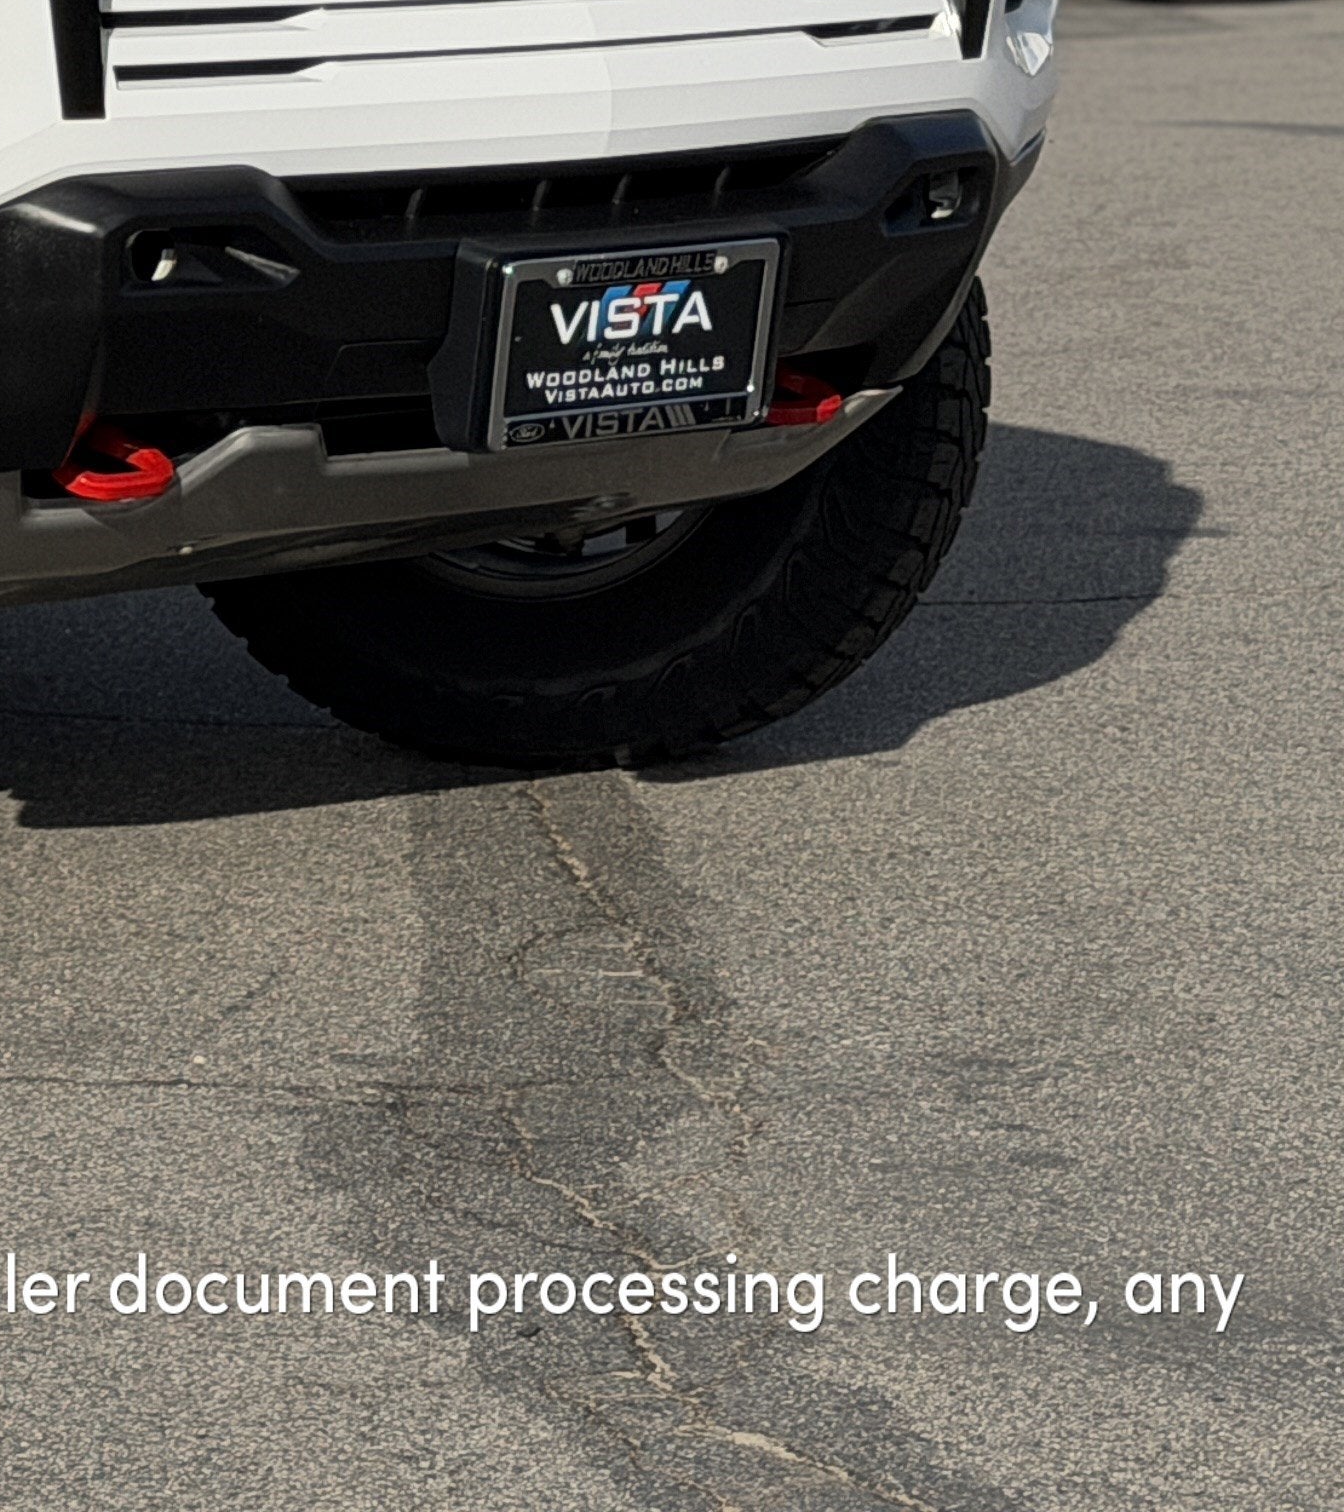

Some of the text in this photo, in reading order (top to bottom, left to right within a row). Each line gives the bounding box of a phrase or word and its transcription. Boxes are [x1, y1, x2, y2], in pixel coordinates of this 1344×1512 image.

[575, 255, 668, 282] WOODLAND
[550, 290, 713, 345] VISTA
[562, 405, 665, 439] VISTA
